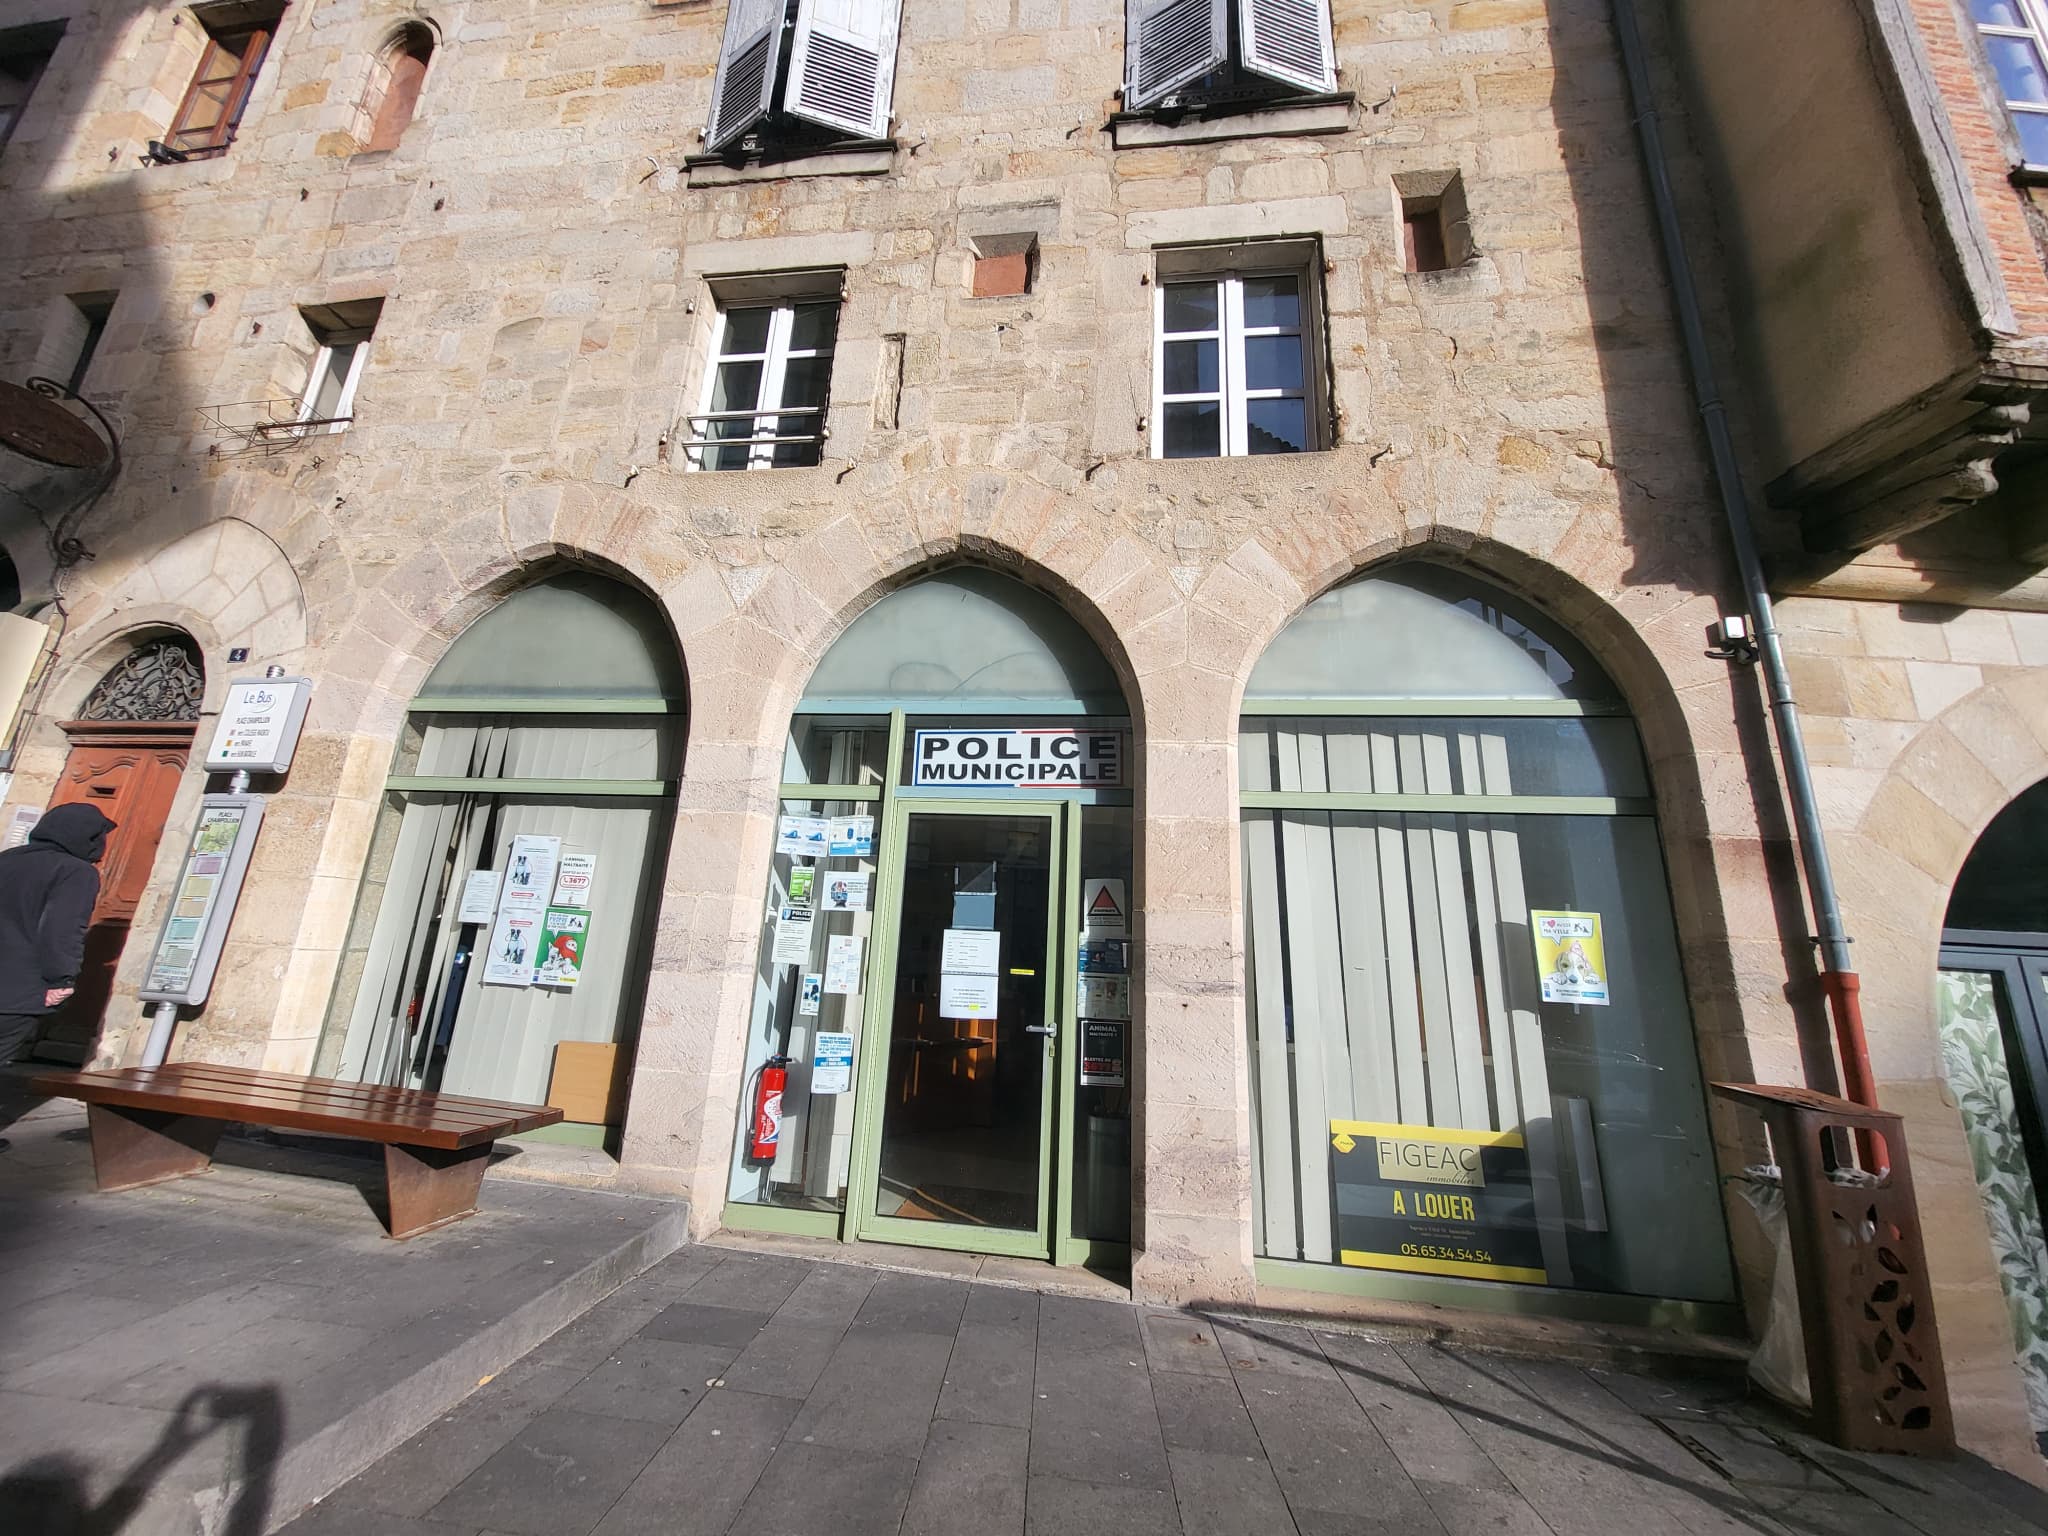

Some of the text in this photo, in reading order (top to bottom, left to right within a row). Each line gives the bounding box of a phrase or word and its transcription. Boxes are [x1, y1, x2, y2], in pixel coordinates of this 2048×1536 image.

[234, 649, 243, 660] 4
[243, 690, 272, 704] Le Bus
[923, 736, 1117, 760] POLICE
[922, 763, 1117, 780] MUNICIPALE
[1089, 1025, 1117, 1033] ANIMAL
[1380, 1141, 1477, 1172] FIGEAC
[1426, 1171, 1476, 1185] immobilier
[1393, 1190, 1476, 1222] A LOUER
[1401, 1243, 1493, 1264] 05.65.34.54.54
